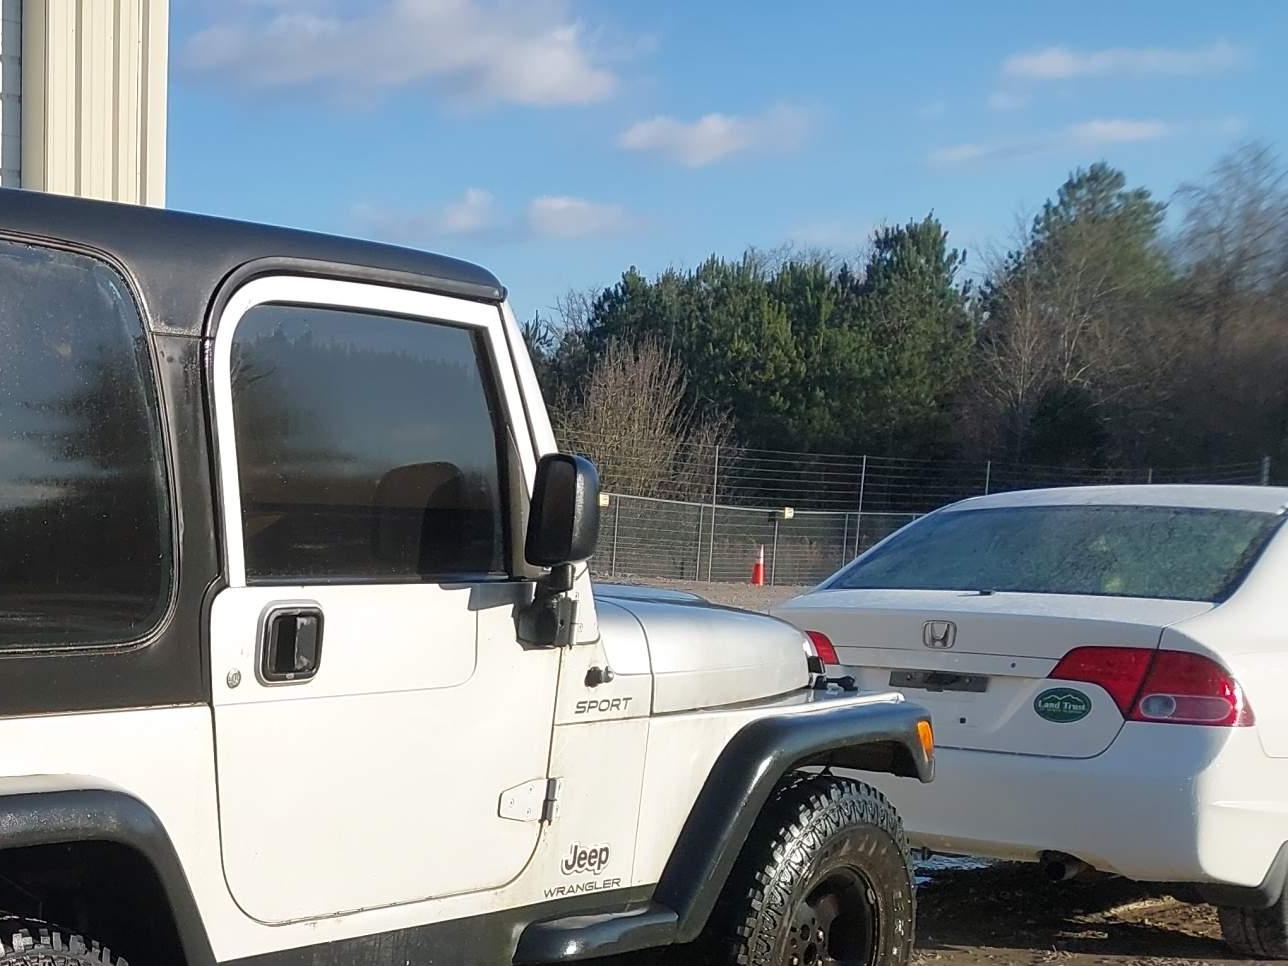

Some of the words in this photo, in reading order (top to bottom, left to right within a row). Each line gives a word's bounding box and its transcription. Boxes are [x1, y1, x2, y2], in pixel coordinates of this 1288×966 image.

[574, 697, 633, 714] SPORT
[1038, 699, 1061, 709] Land
[1062, 701, 1086, 711] Trust
[563, 844, 610, 873] Jeep
[543, 877, 622, 898] WRANGLER
